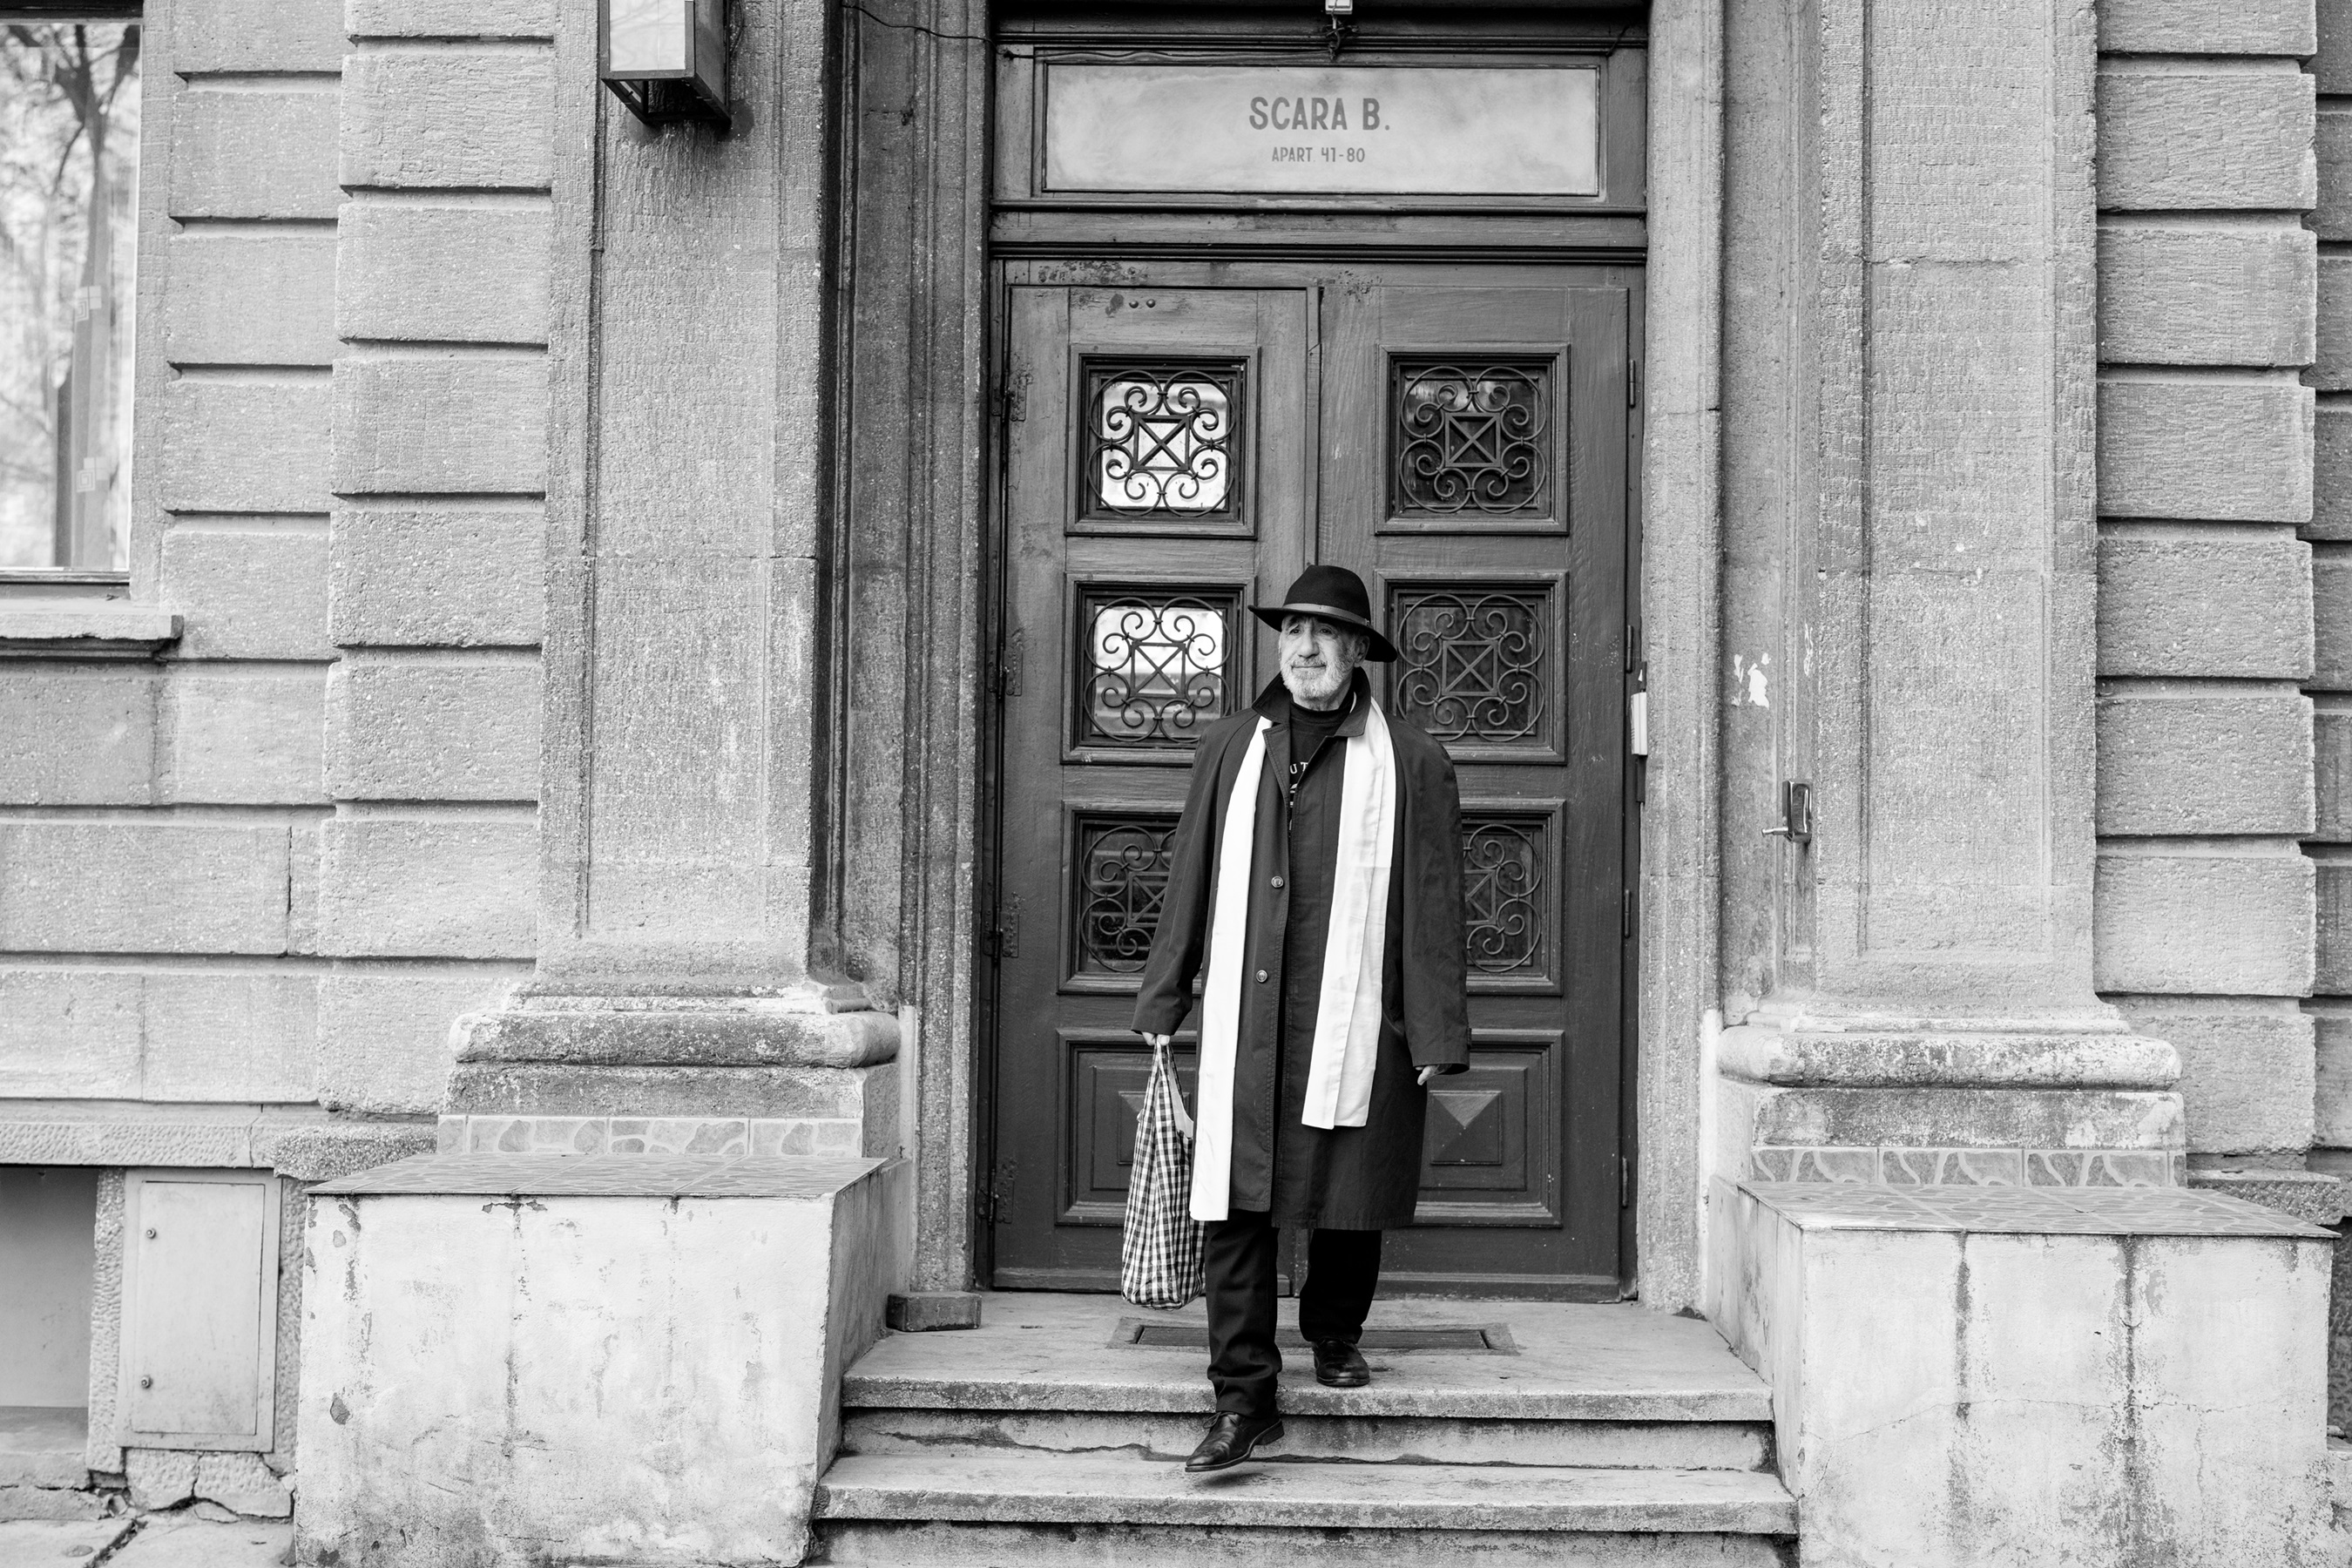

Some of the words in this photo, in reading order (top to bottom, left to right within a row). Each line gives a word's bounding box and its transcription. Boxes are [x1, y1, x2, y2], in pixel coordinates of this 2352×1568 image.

[1249, 97, 1348, 131] SCARA
[1362, 98, 1390, 131] B.
[1321, 146, 1365, 163] 41-80
